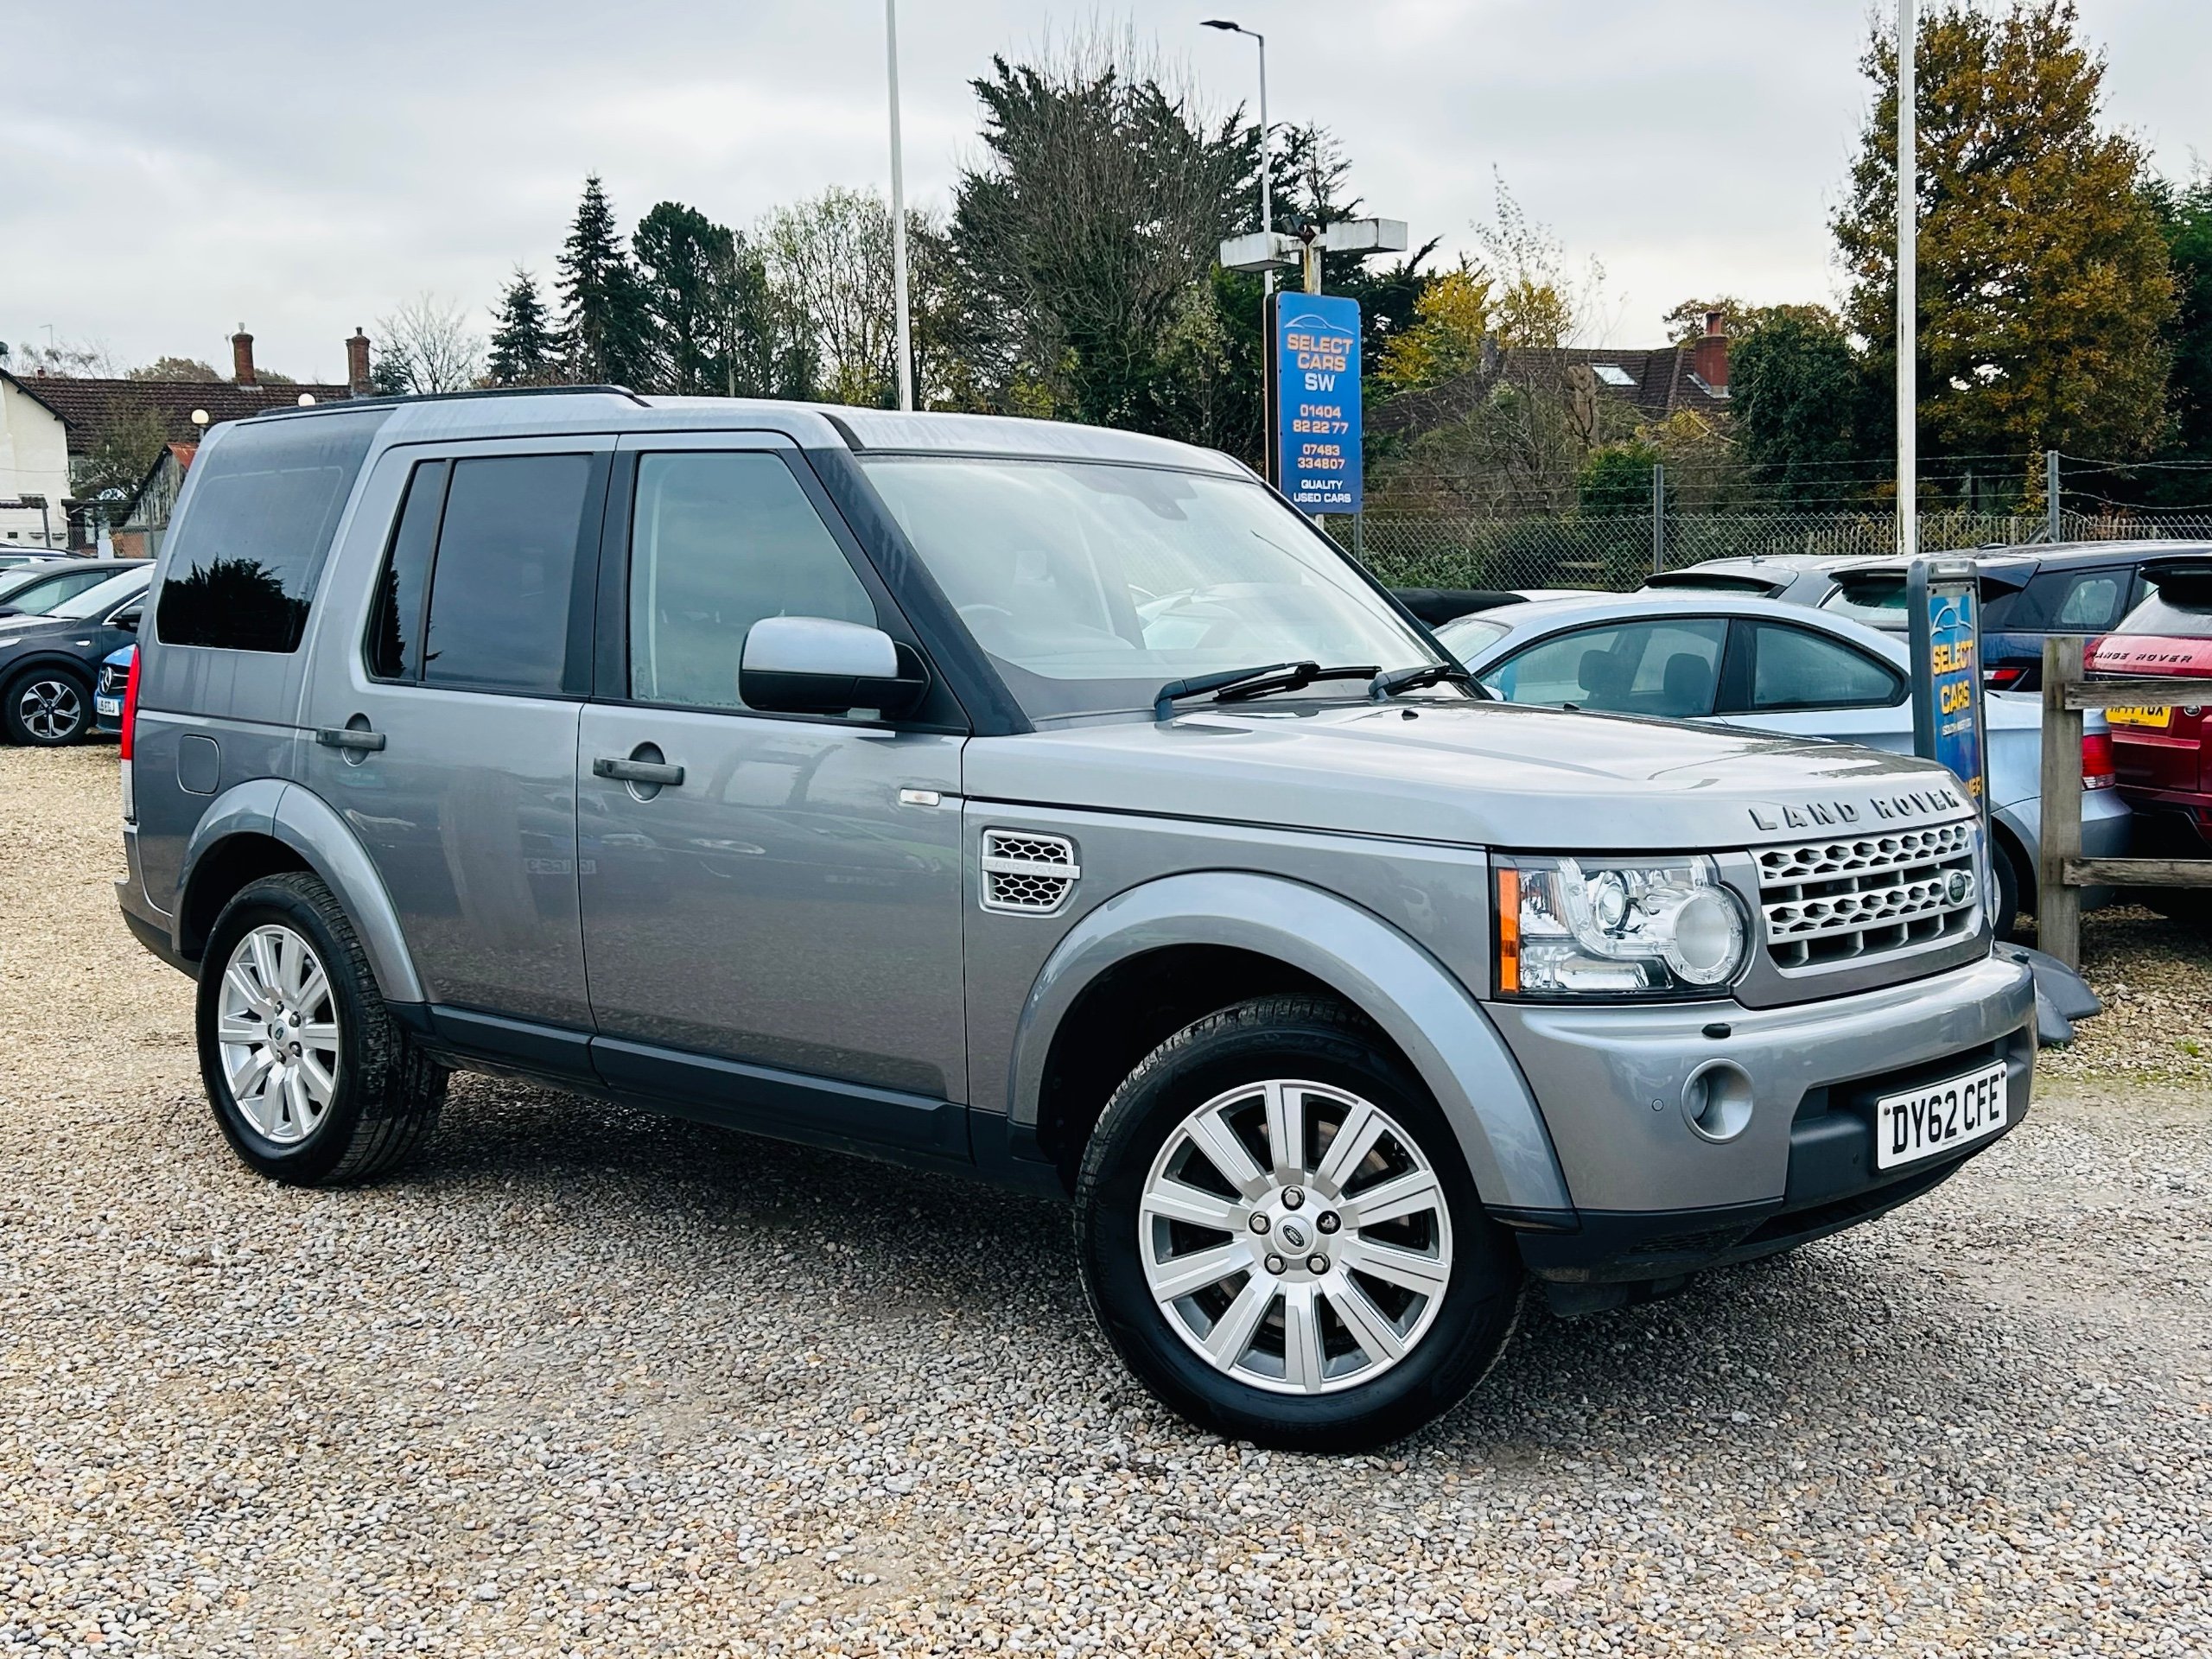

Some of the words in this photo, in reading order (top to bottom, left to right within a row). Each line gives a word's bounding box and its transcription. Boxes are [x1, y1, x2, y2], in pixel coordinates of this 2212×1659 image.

[1287, 333, 1354, 355] SELECT
[1297, 353, 1346, 372] CARS
[1305, 372, 1335, 391] SW
[1300, 404, 1341, 419] 01404
[1302, 443, 1340, 456] 07483
[1298, 457, 1345, 469] 334807
[1300, 479, 1343, 490] QUALITY
[1294, 491, 1322, 503] USED
[1323, 492, 1351, 504] CARS
[1932, 639, 1974, 676] SELECT
[2136, 653, 2193, 663] ROVER
[1941, 679, 1970, 715] CARS
[1748, 801, 1859, 830] LAND
[1870, 788, 1960, 818] ROVER
[985, 861, 1020, 871] LAND
[1028, 864, 1073, 876] ROVER
[1892, 1090, 1957, 1154] DY62
[1964, 1073, 1999, 1131] CFE
